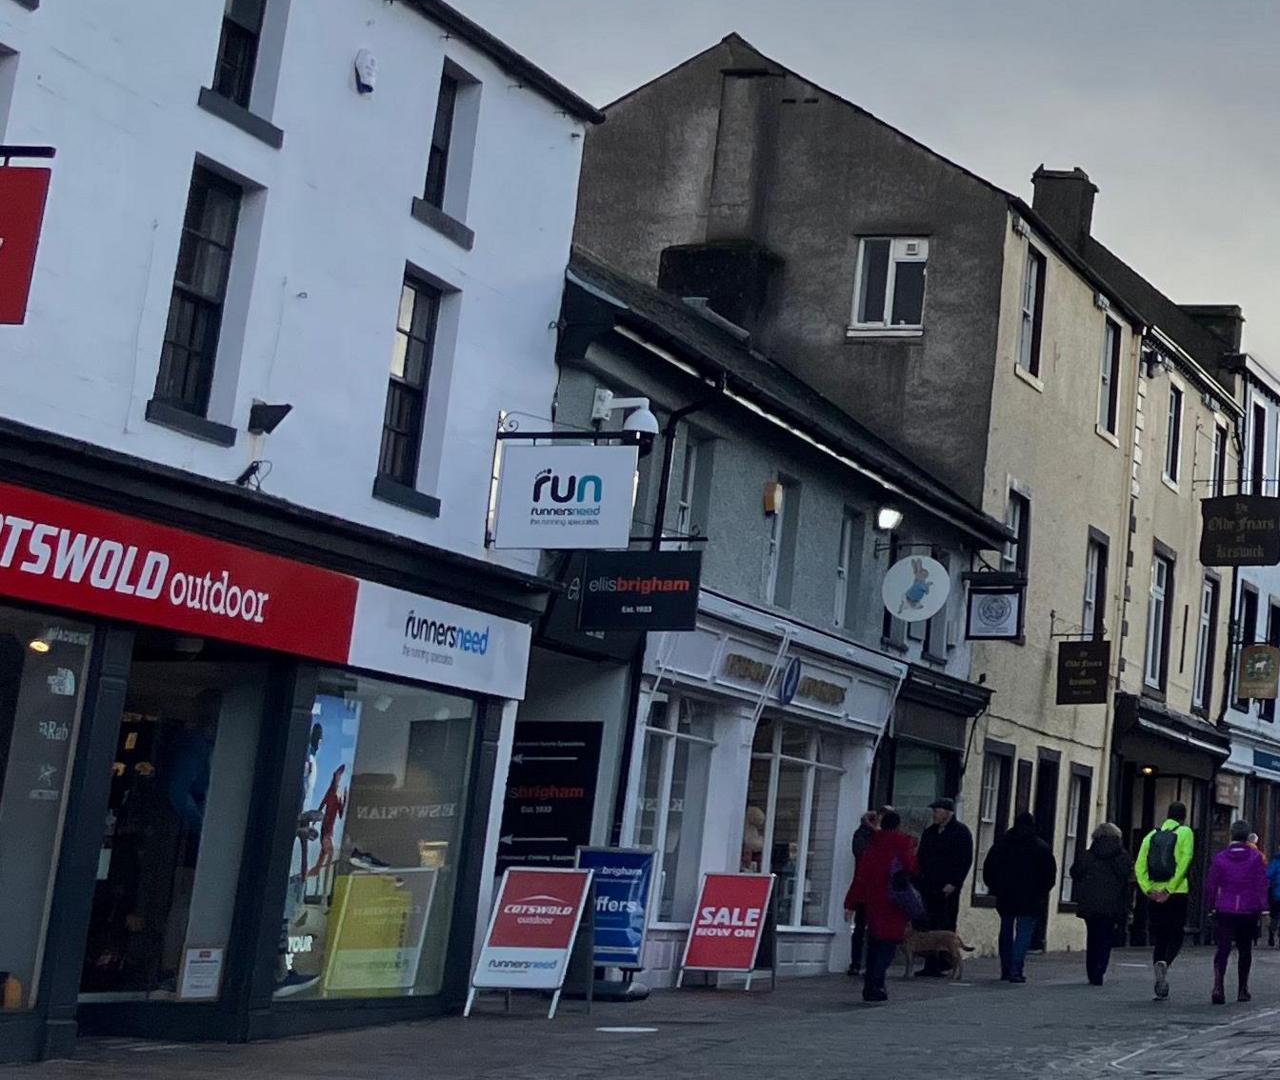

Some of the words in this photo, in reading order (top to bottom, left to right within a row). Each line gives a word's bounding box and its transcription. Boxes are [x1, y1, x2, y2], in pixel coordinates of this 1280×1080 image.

[533, 469, 602, 503] run
[530, 506, 600, 516] runnersneed
[1207, 516, 1234, 530] Olde
[1236, 517, 1274, 532] Friars
[1216, 545, 1264, 558] Keswick
[0, 514, 170, 600] TSWOLD
[170, 570, 269, 623] outdoor
[589, 577, 689, 594] ellisbrigham
[405, 610, 489, 655] runnersneed
[47, 722, 68, 740] Rab
[511, 785, 585, 800] sbrigham
[600, 867, 642, 877] brigham
[504, 904, 574, 915] COTSWOLD
[595, 896, 637, 912] ffers
[517, 916, 554, 924] outdoor
[699, 907, 760, 926] SALE
[696, 928, 731, 936] NOW
[734, 929, 755, 937] ON
[488, 959, 558, 969] runnersneed
